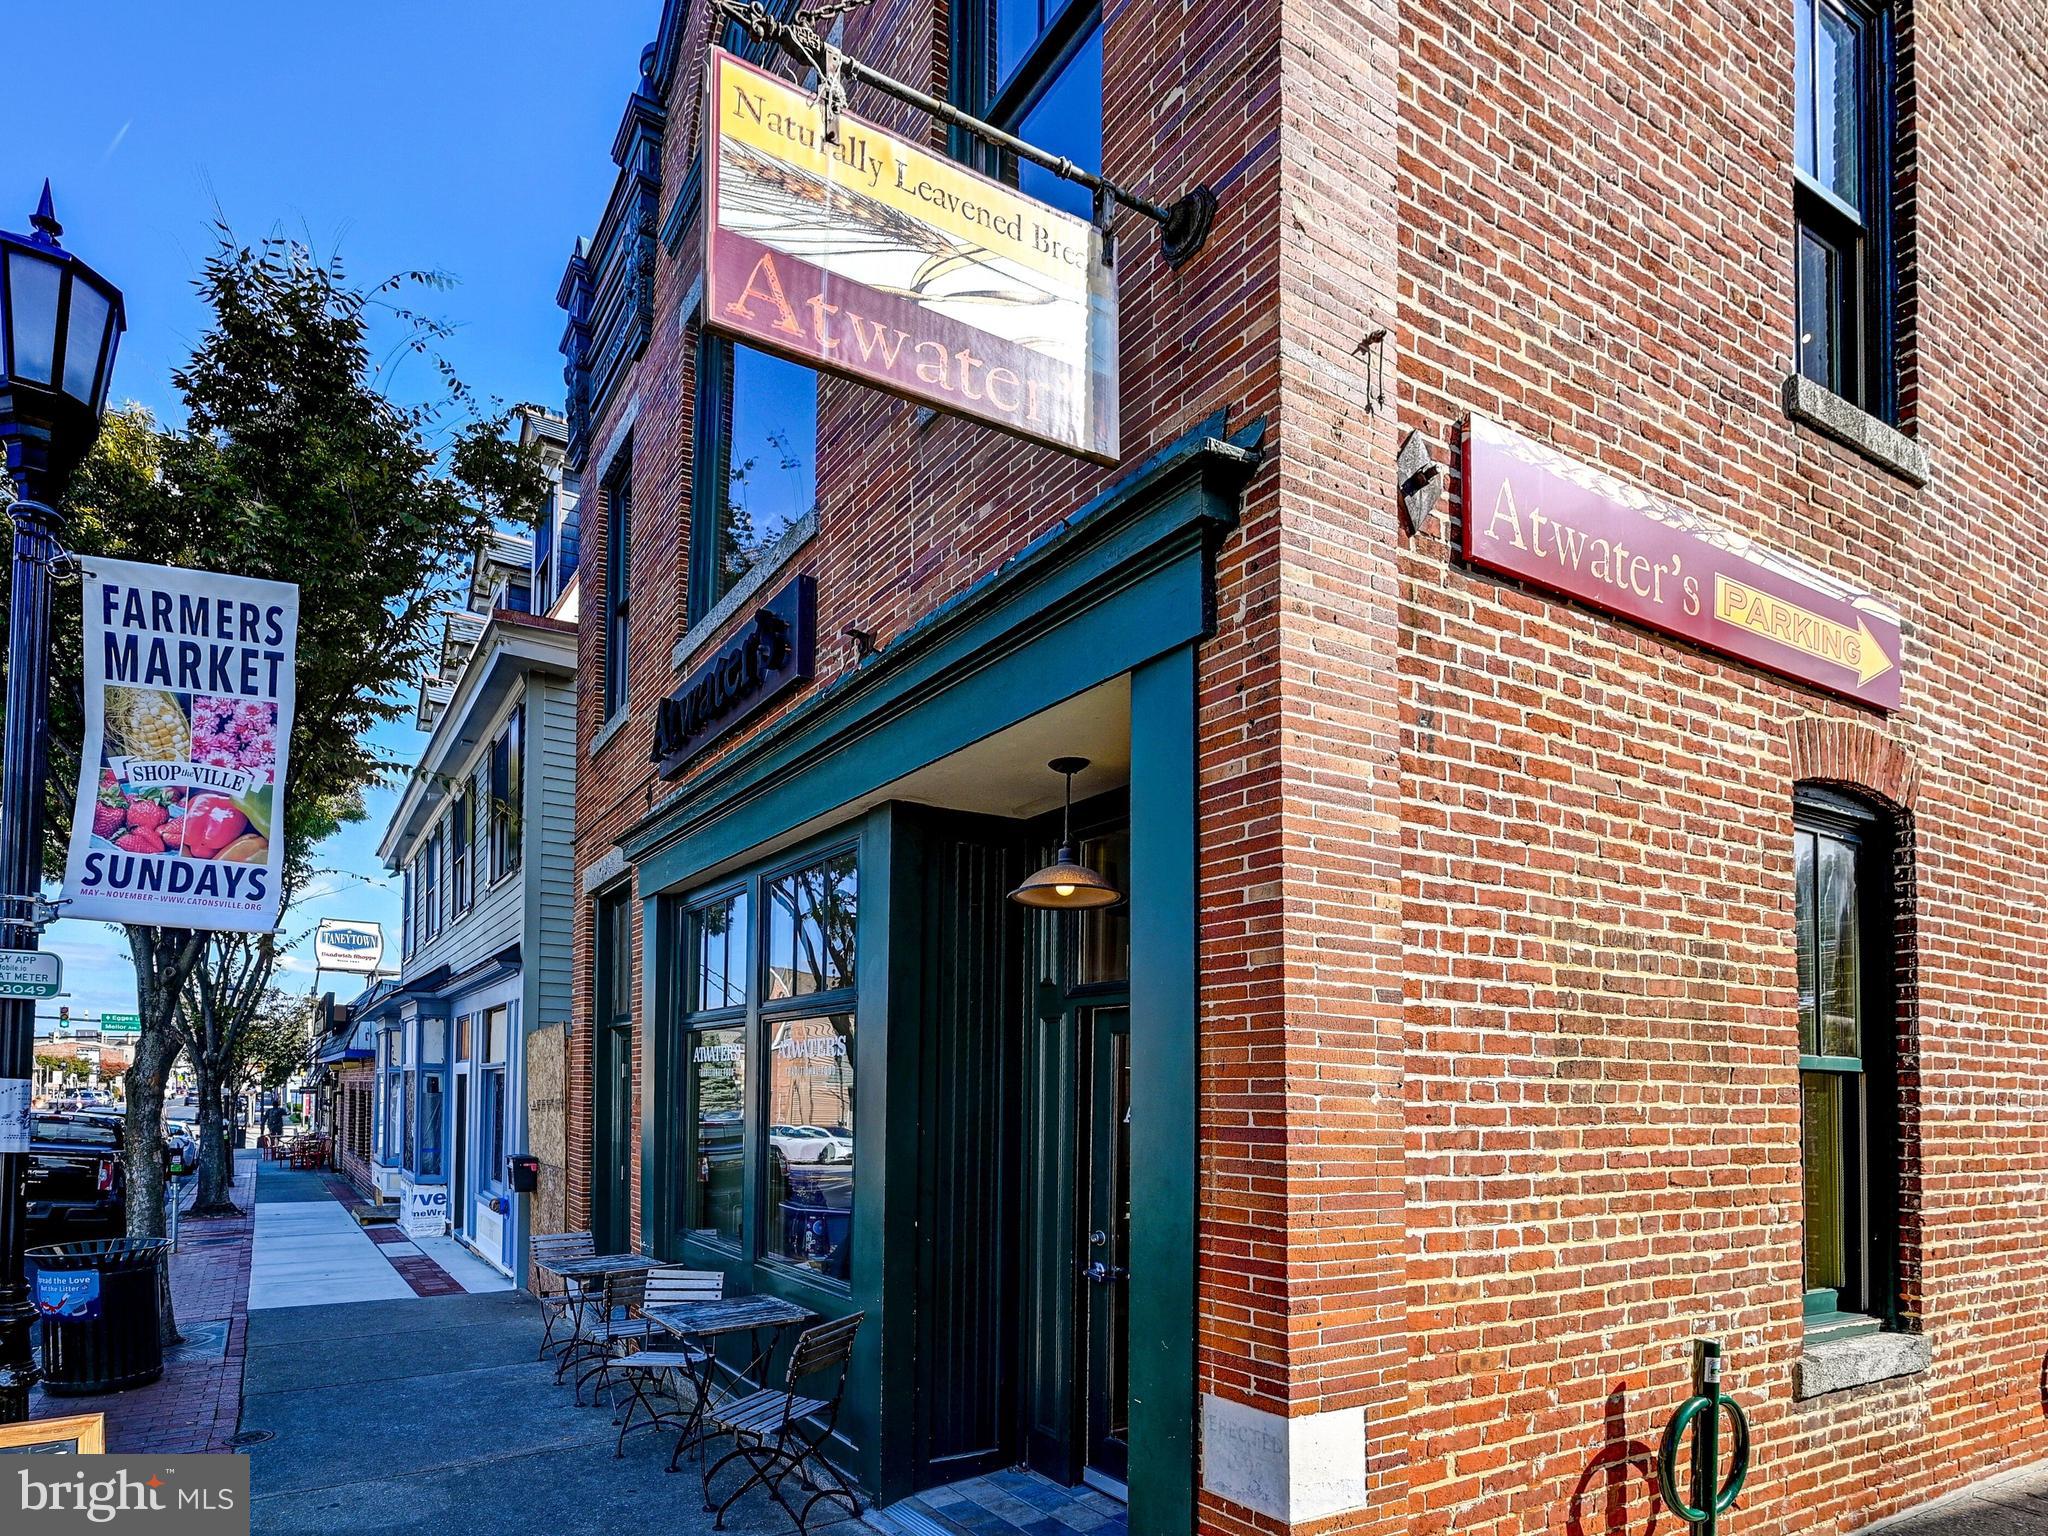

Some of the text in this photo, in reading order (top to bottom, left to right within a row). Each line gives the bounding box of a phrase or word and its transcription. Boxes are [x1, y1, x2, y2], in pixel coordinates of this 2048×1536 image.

[733, 85, 883, 188] Naturally
[895, 159, 1023, 242] Leavened
[1483, 477, 1701, 617] Atwater's
[102, 583, 285, 647] FARMERS
[1723, 582, 1862, 665] PARKING
[103, 630, 285, 698] MARKET
[133, 764, 182, 783] SHOP
[193, 766, 246, 793] VILLE
[80, 852, 269, 902] SUNDAYS
[15, 956, 37, 965] APP
[323, 932, 378, 949] TANEYTOWN
[14, 973, 49, 982] METER
[69, 1276, 91, 1284] Love
